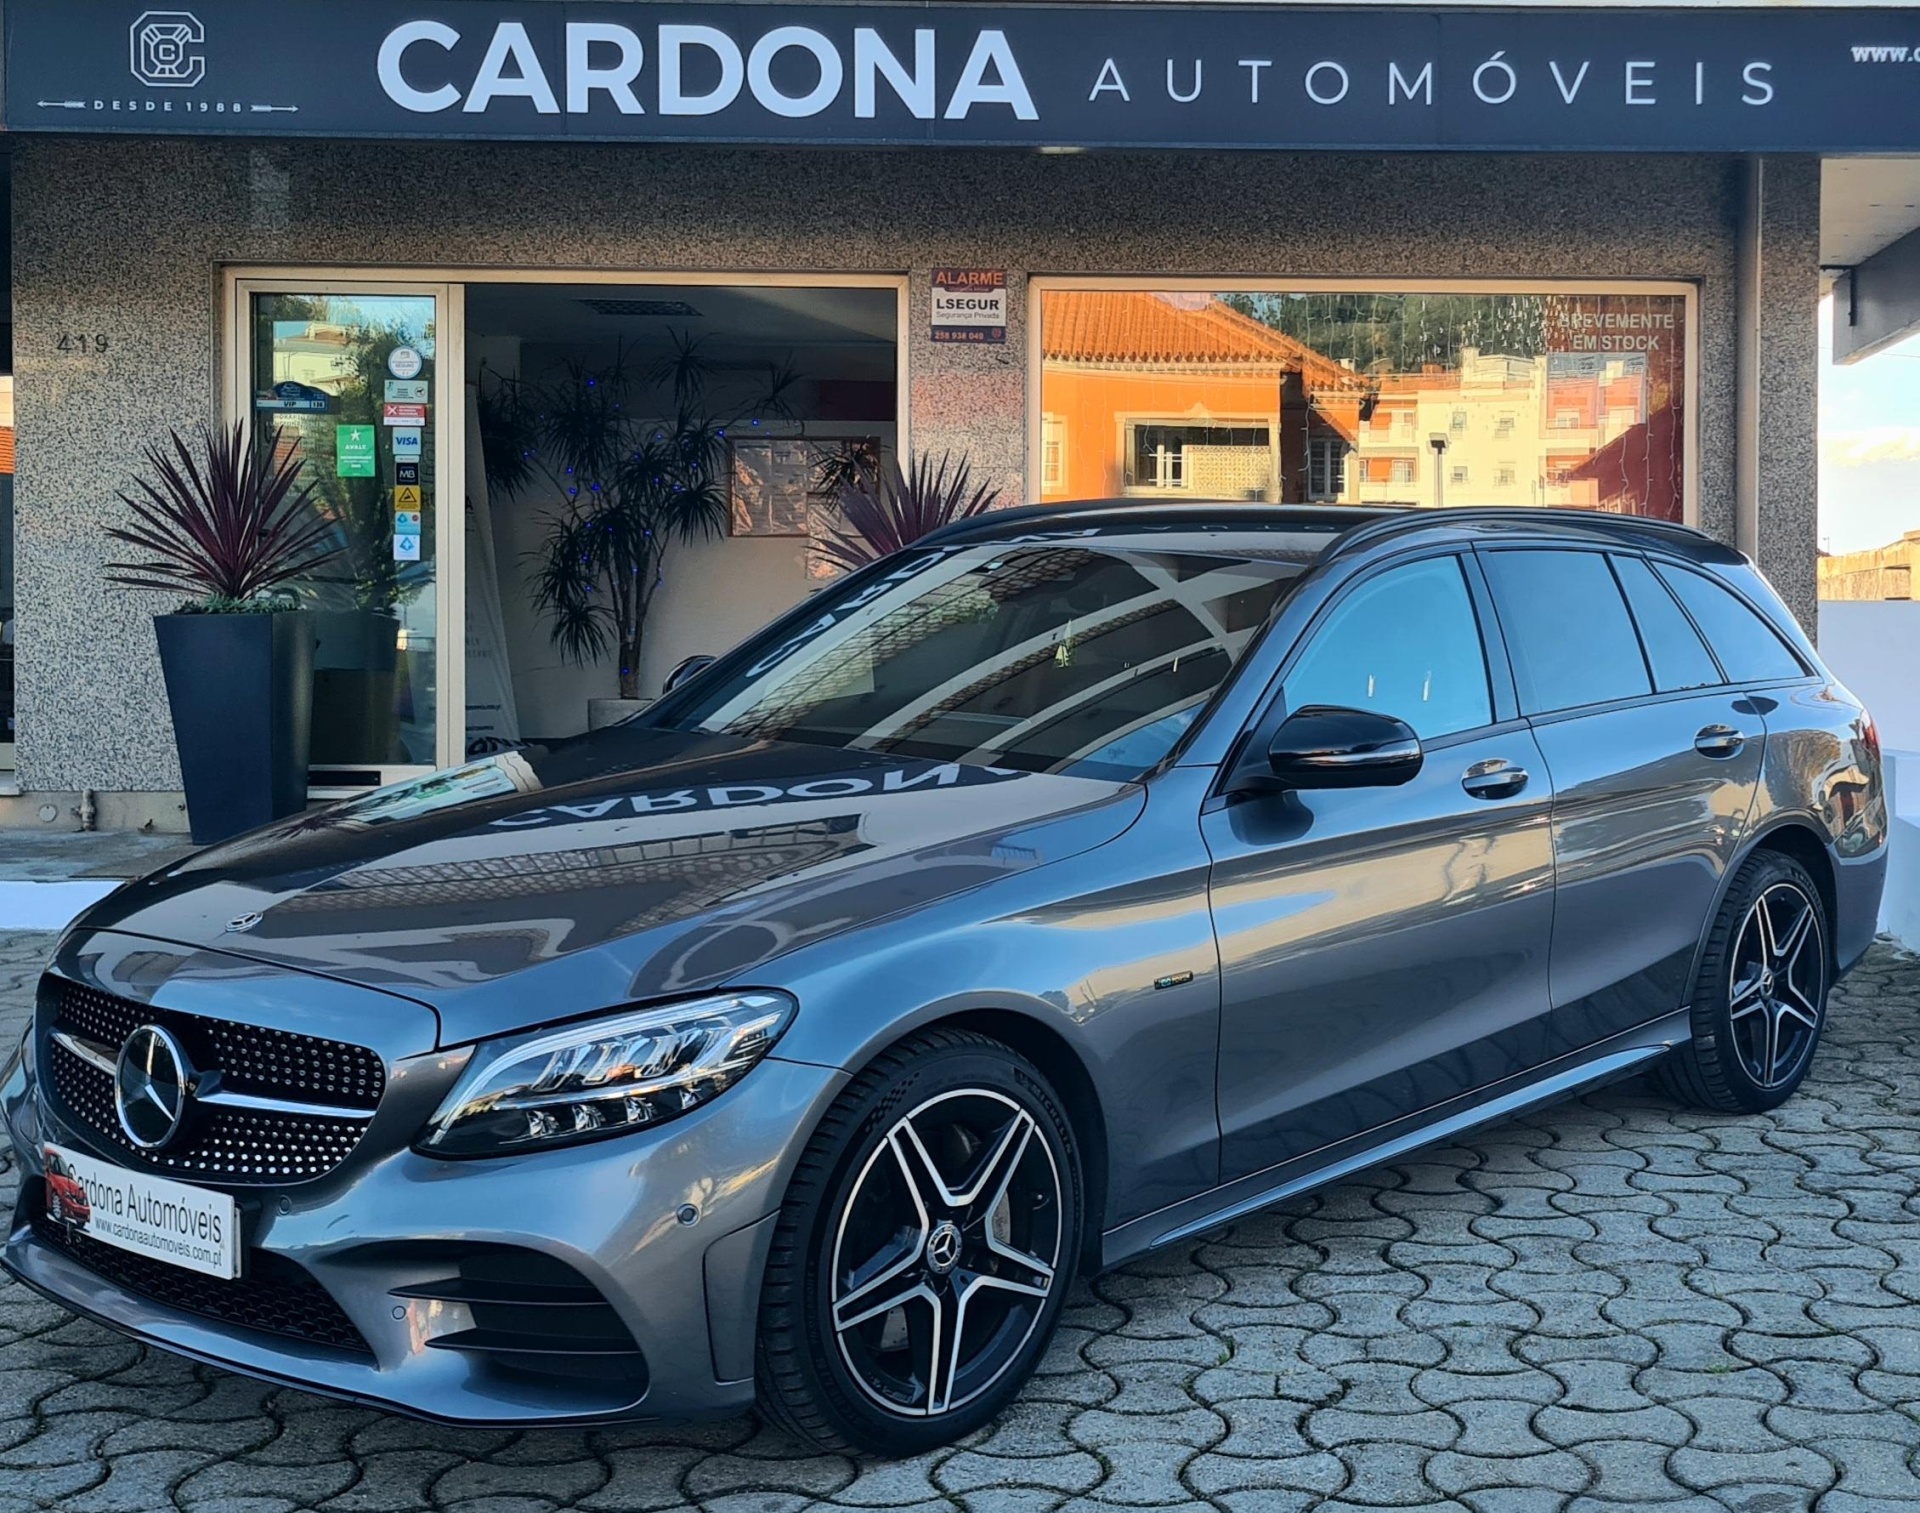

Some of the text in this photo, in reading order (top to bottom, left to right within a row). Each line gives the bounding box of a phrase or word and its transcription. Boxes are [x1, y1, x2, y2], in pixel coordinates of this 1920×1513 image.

[376, 19, 1775, 121] CARDONA AUTOMÓVEIS
[94, 100, 242, 113] DESDE 1988
[936, 271, 1003, 286] ALARME
[936, 298, 999, 310] LSEGUR
[936, 311, 1000, 320] Segurança Privada
[1560, 313, 1675, 329] BREVEMENTE
[57, 333, 108, 353] 419
[1573, 335, 1660, 350] EM STOCK
[395, 437, 418, 445] VISA
[399, 469, 415, 478] MB
[68, 1163, 222, 1244] Cardona Automóveis
[95, 1216, 222, 1268] www.cardonaautomoveis.com.pt
